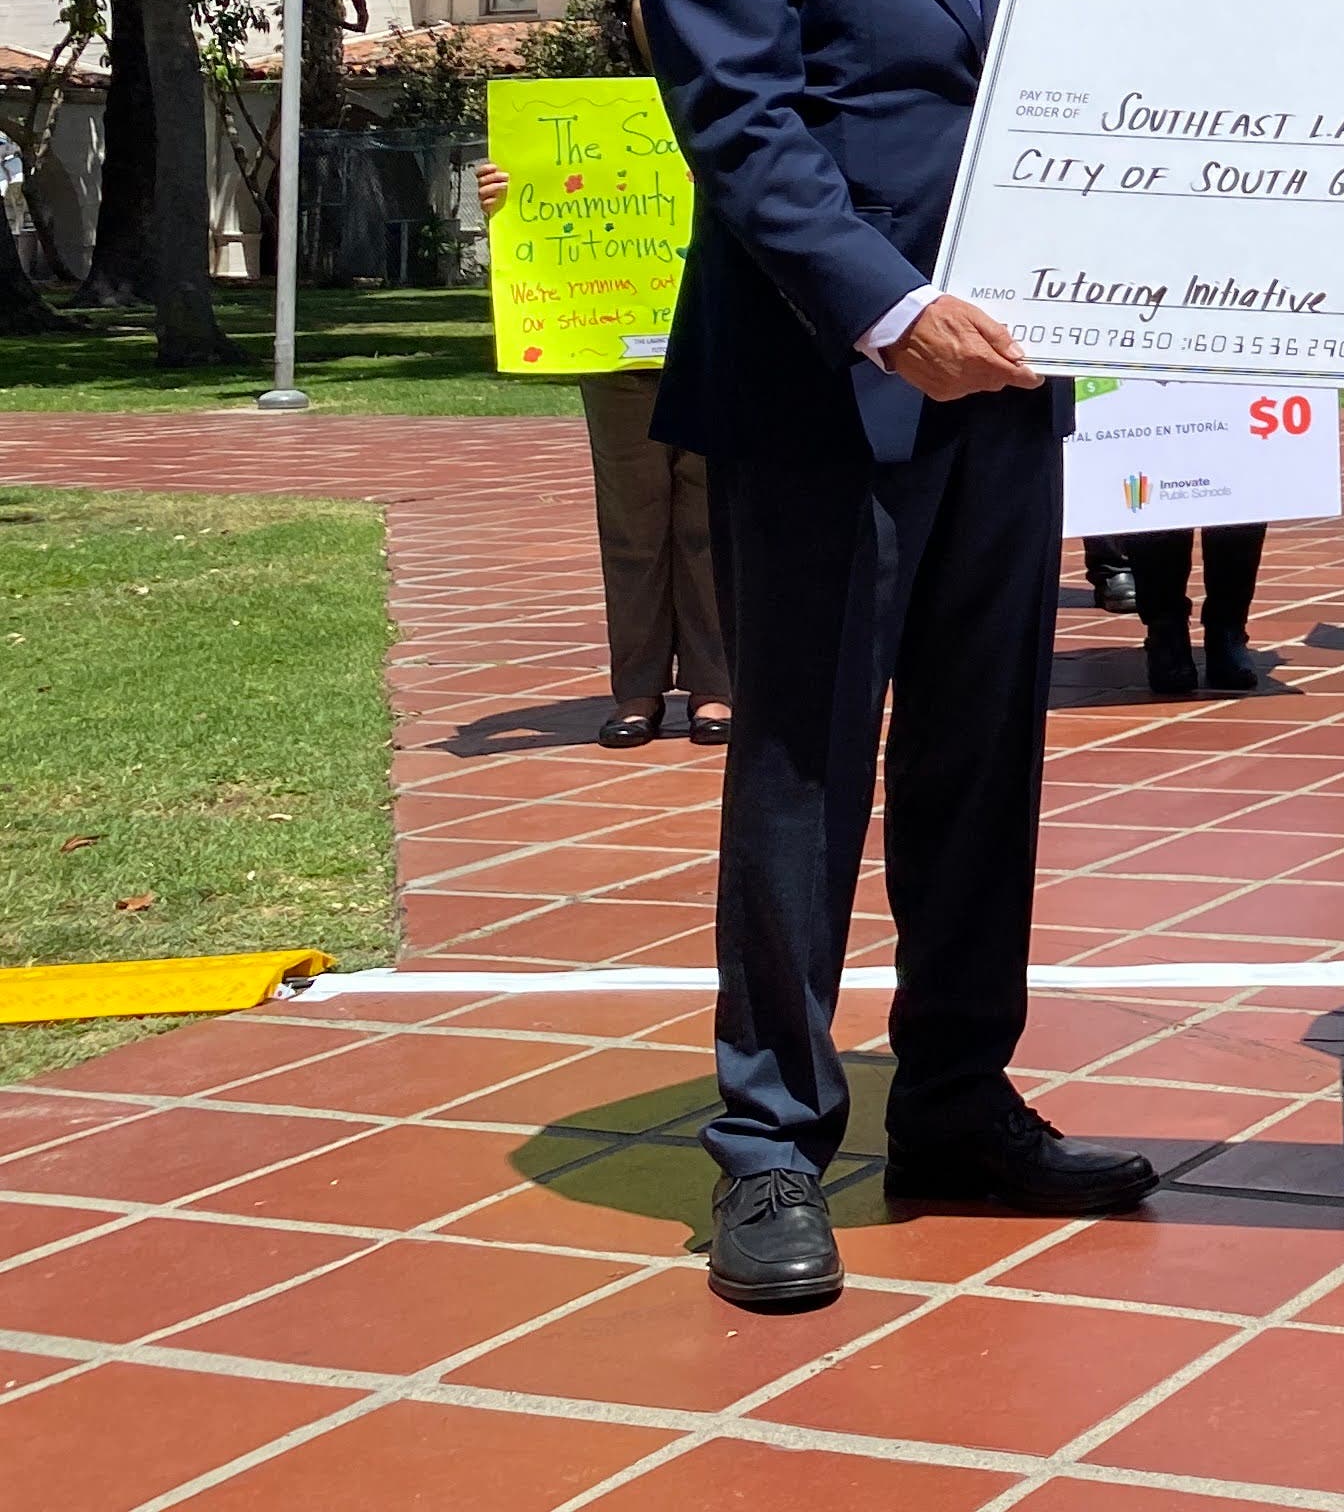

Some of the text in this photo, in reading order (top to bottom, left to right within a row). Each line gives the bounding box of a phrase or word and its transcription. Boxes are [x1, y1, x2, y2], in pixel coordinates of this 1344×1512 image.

[1015, 104, 1080, 119] ORDER OF
[1019, 89, 1090, 104] PAY TO THE
[1101, 92, 1297, 140] SOUTHEAST
[538, 114, 602, 166] The
[1012, 148, 1105, 197] CITY
[1120, 165, 1171, 189] OF
[1190, 160, 1309, 196] SOUTH
[519, 171, 675, 225] Community
[515, 229, 673, 265] a Tutoring
[568, 277, 638, 298] running
[970, 266, 1329, 322] MEMO Tutoring Initiative
[1096, 427, 1151, 441] GASTADO
[1156, 426, 1171, 436] EN
[1249, 395, 1312, 440] $0
[1160, 478, 1210, 489] Innovate
[1160, 486, 1232, 501] Public Schools
